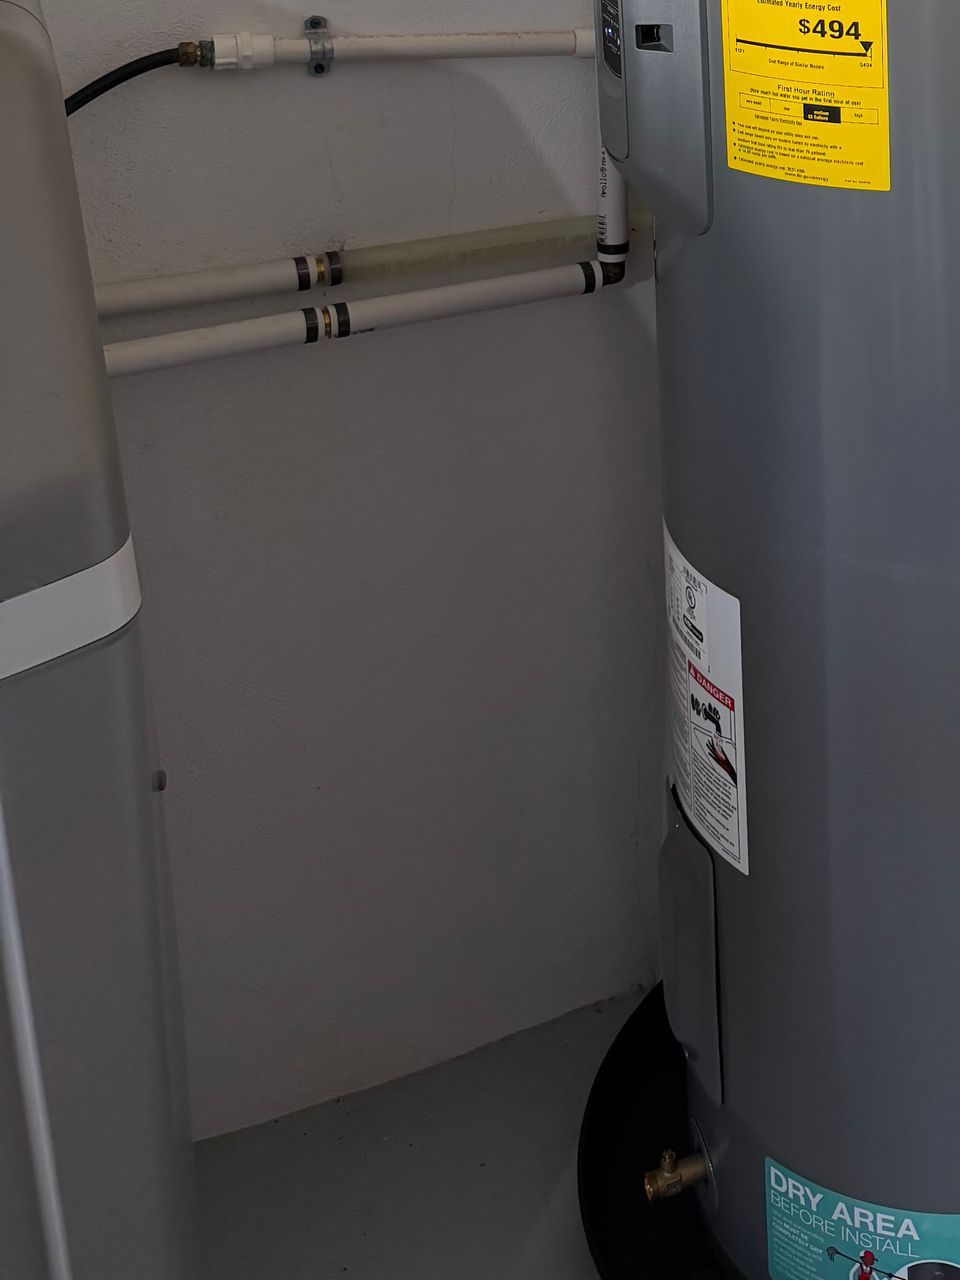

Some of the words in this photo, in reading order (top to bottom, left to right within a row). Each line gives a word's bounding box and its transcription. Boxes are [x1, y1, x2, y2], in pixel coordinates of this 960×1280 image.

[784, 0, 803, 10] Yearly
[804, 2, 826, 12] Energy
[827, 4, 841, 12] Cost
[798, 18, 862, 41] $494
[777, 84, 793, 93] First
[793, 86, 811, 96] Hour
[811, 88, 836, 99] Rating
[694, 672, 734, 709] DANGER
[770, 1166, 824, 1212] DRY
[831, 1201, 920, 1241] AREA
[771, 1190, 836, 1238] BEFORE
[841, 1225, 920, 1258] INSTALL
